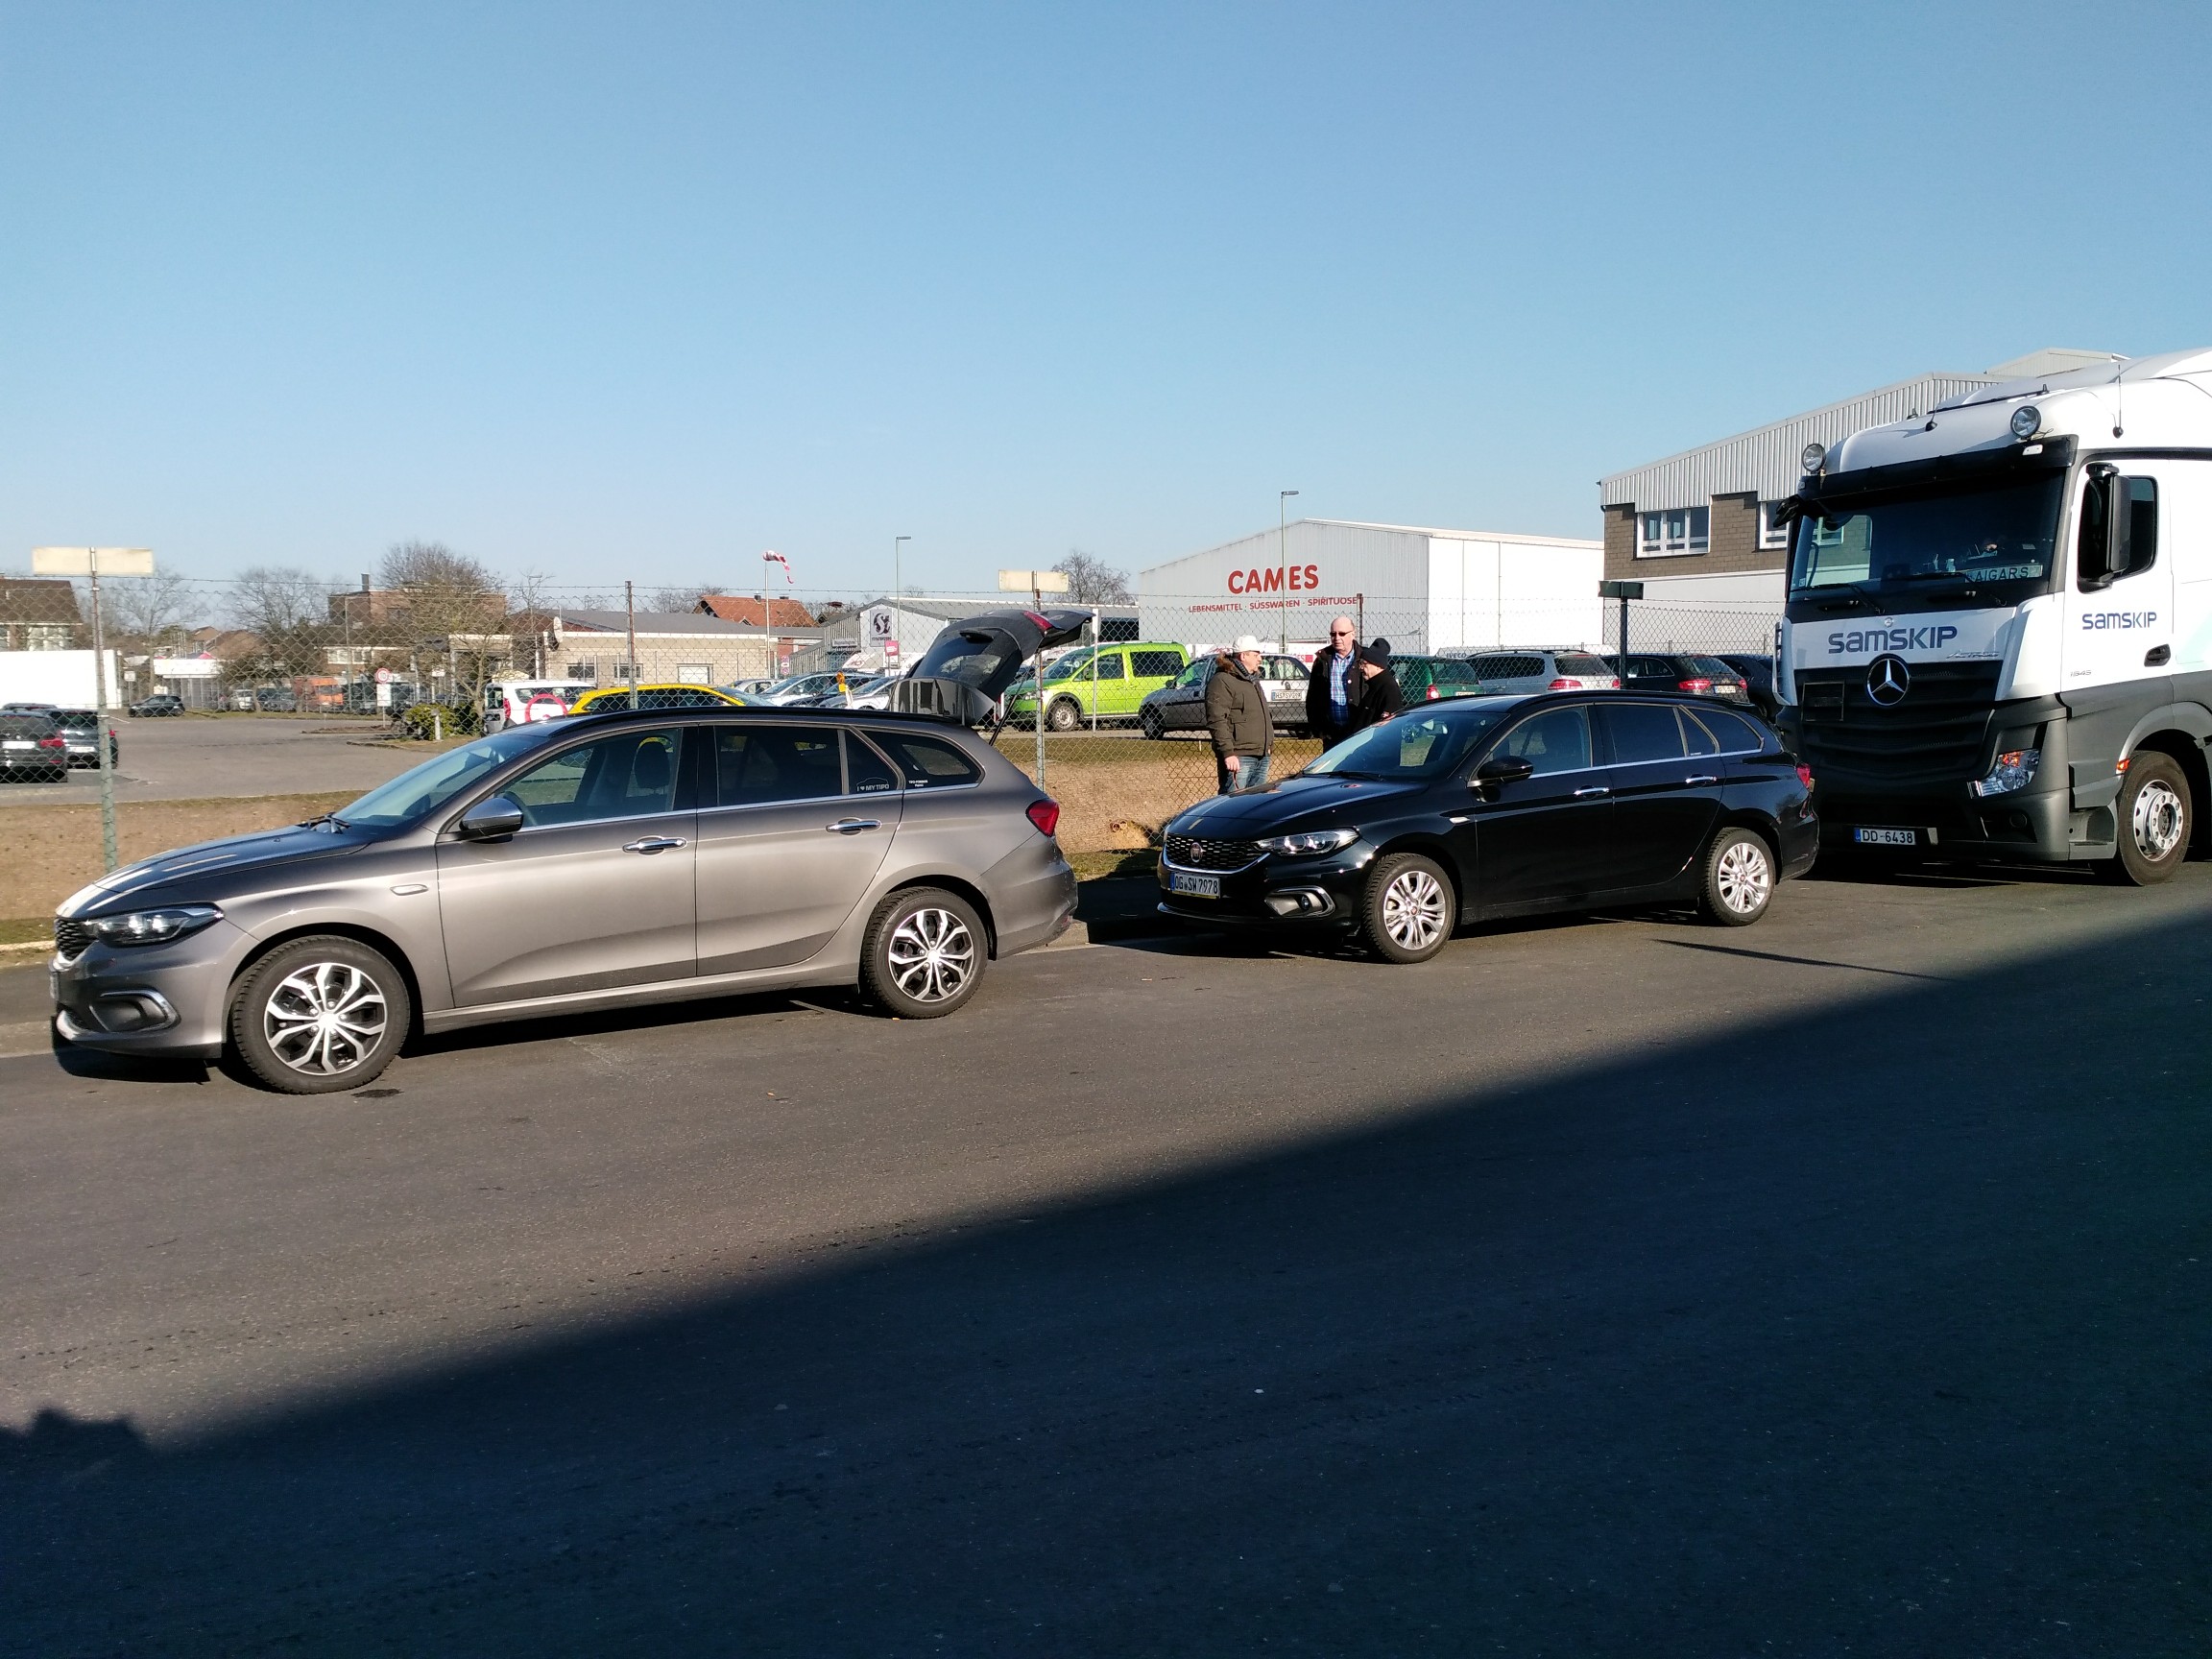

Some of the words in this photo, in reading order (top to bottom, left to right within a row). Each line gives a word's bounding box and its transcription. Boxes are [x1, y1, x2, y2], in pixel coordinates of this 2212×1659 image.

[1228, 565, 1319, 594] CAMES
[1976, 566, 2029, 582] AIGARS
[1189, 603, 1242, 613] LEBENSMITTEL
[1250, 599, 1301, 610] SÜSSWAREN
[1308, 596, 1364, 607] SPIRITUOSE
[1862, 830, 1913, 844] DD-6438
[1198, 878, 1218, 894] 7978
